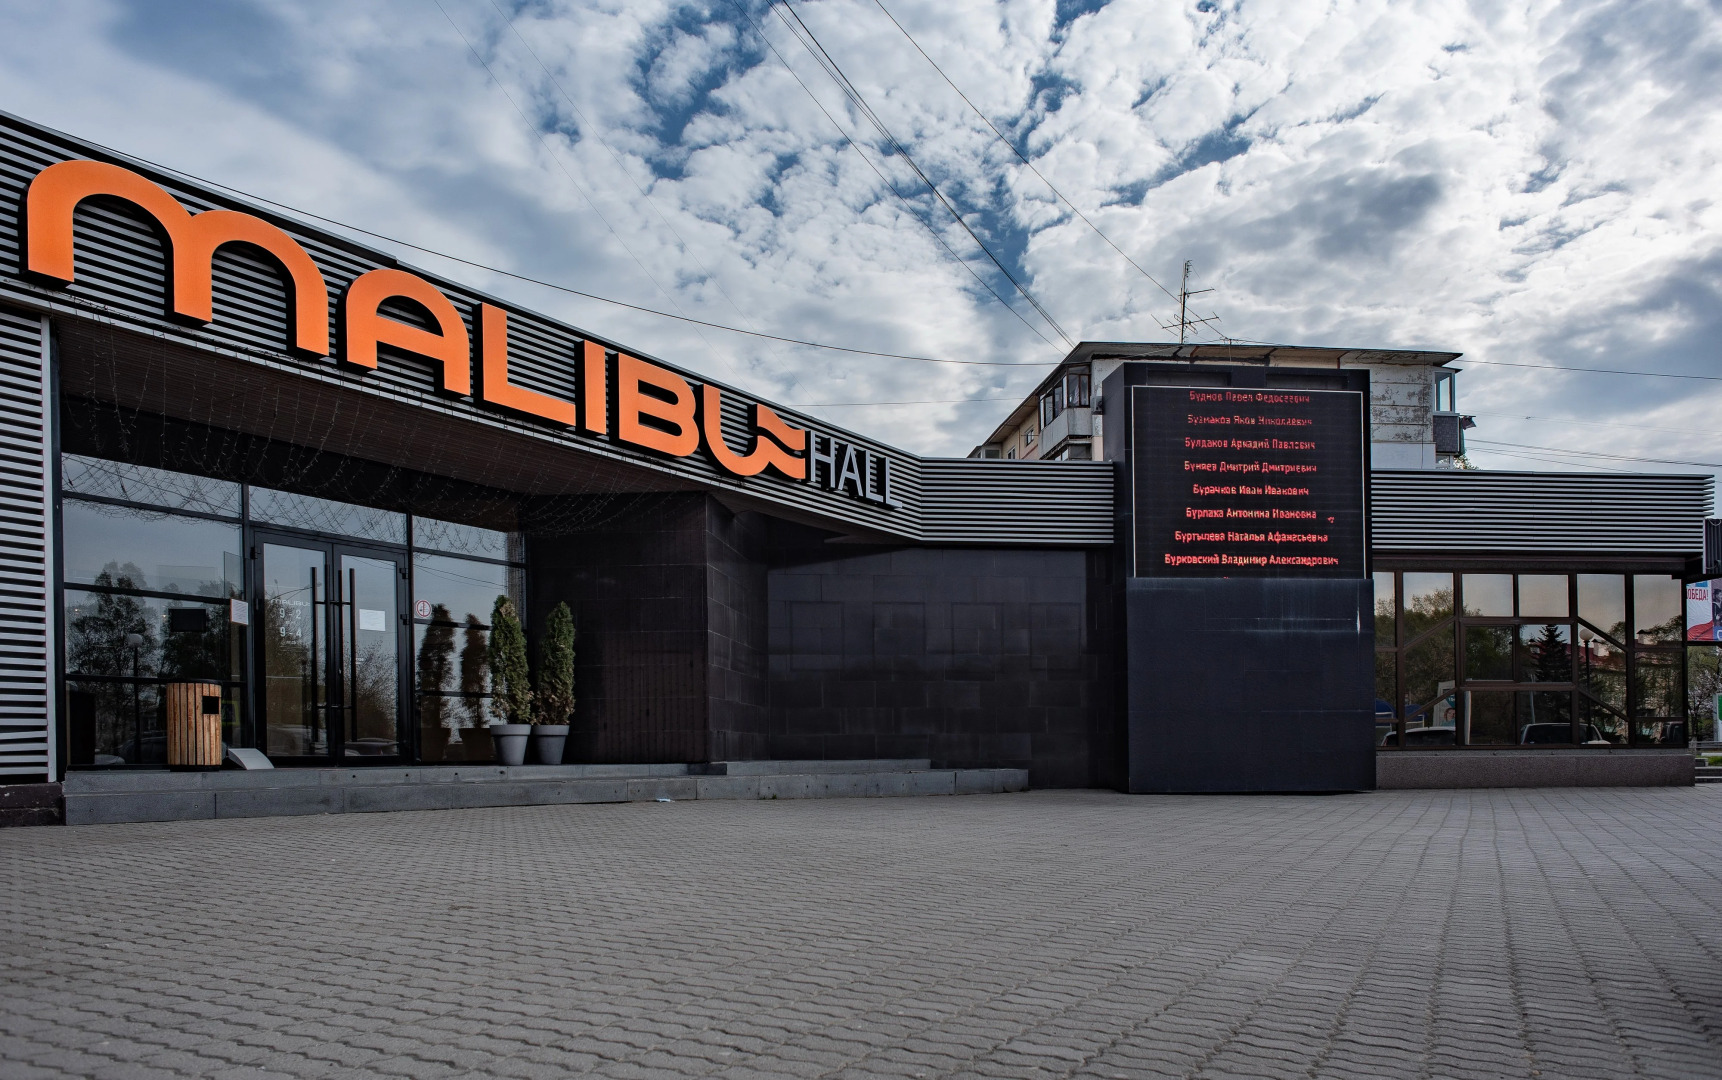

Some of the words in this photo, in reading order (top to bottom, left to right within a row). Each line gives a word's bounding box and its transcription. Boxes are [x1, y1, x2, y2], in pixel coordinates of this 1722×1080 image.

[25, 159, 806, 479] MALIBU
[810, 429, 903, 509] HALL
[1225, 391, 1253, 403] Павел
[1233, 415, 1256, 425] Яков
[1184, 436, 1228, 449] Булдаков
[1230, 438, 1270, 450] Аркадий
[1272, 438, 1316, 450] Павлович
[1219, 461, 1260, 474] Дмитрий
[1261, 462, 1317, 475] Дмитриевич
[1192, 483, 1237, 496] Бурачков
[1239, 484, 1263, 495] Иван
[1264, 485, 1310, 496] Иванович
[1185, 507, 1224, 520] Бурлака
[1226, 508, 1270, 519] Антонина
[1272, 508, 1318, 519] Ивановна
[1174, 530, 1226, 543] Буртылева
[1227, 531, 1266, 542] Наталья
[1267, 531, 1329, 544] Афанасьевна
[1164, 553, 1220, 566] Бурковский
[1221, 553, 1268, 567] Владимир
[1269, 554, 1339, 568] Александрович
[1687, 588, 1709, 602] ОБЕДА!
[279, 607, 286, 619] 9
[280, 626, 286, 638] 9
